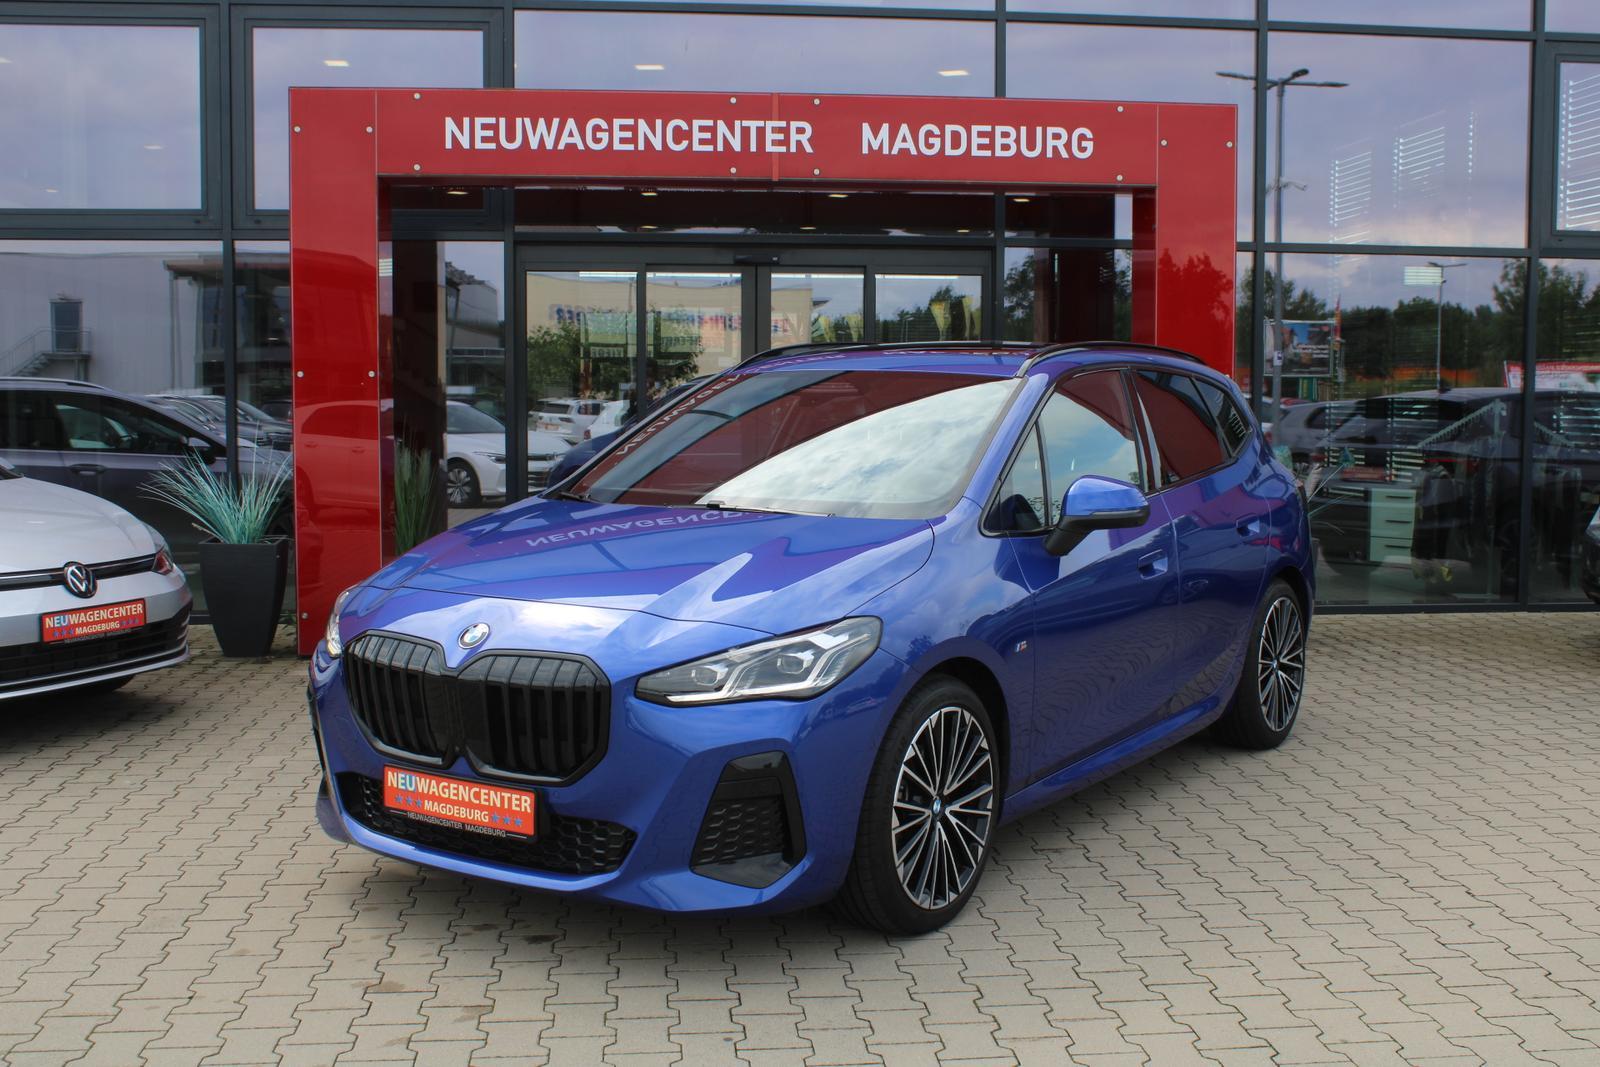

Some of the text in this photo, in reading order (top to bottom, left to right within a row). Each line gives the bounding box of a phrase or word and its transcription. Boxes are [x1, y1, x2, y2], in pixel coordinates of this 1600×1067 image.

[444, 116, 1095, 159] NEUWAGENCENTER MAGDEBURG
[45, 603, 144, 629] NEUWAGENCENTER
[75, 621, 120, 635] MAGDEBURG
[387, 771, 532, 813] NEUWAGENCENTER
[407, 811, 507, 838] NEUWAGENCENTER MAGDEBURG
[424, 800, 489, 823] MAGDEBURG
